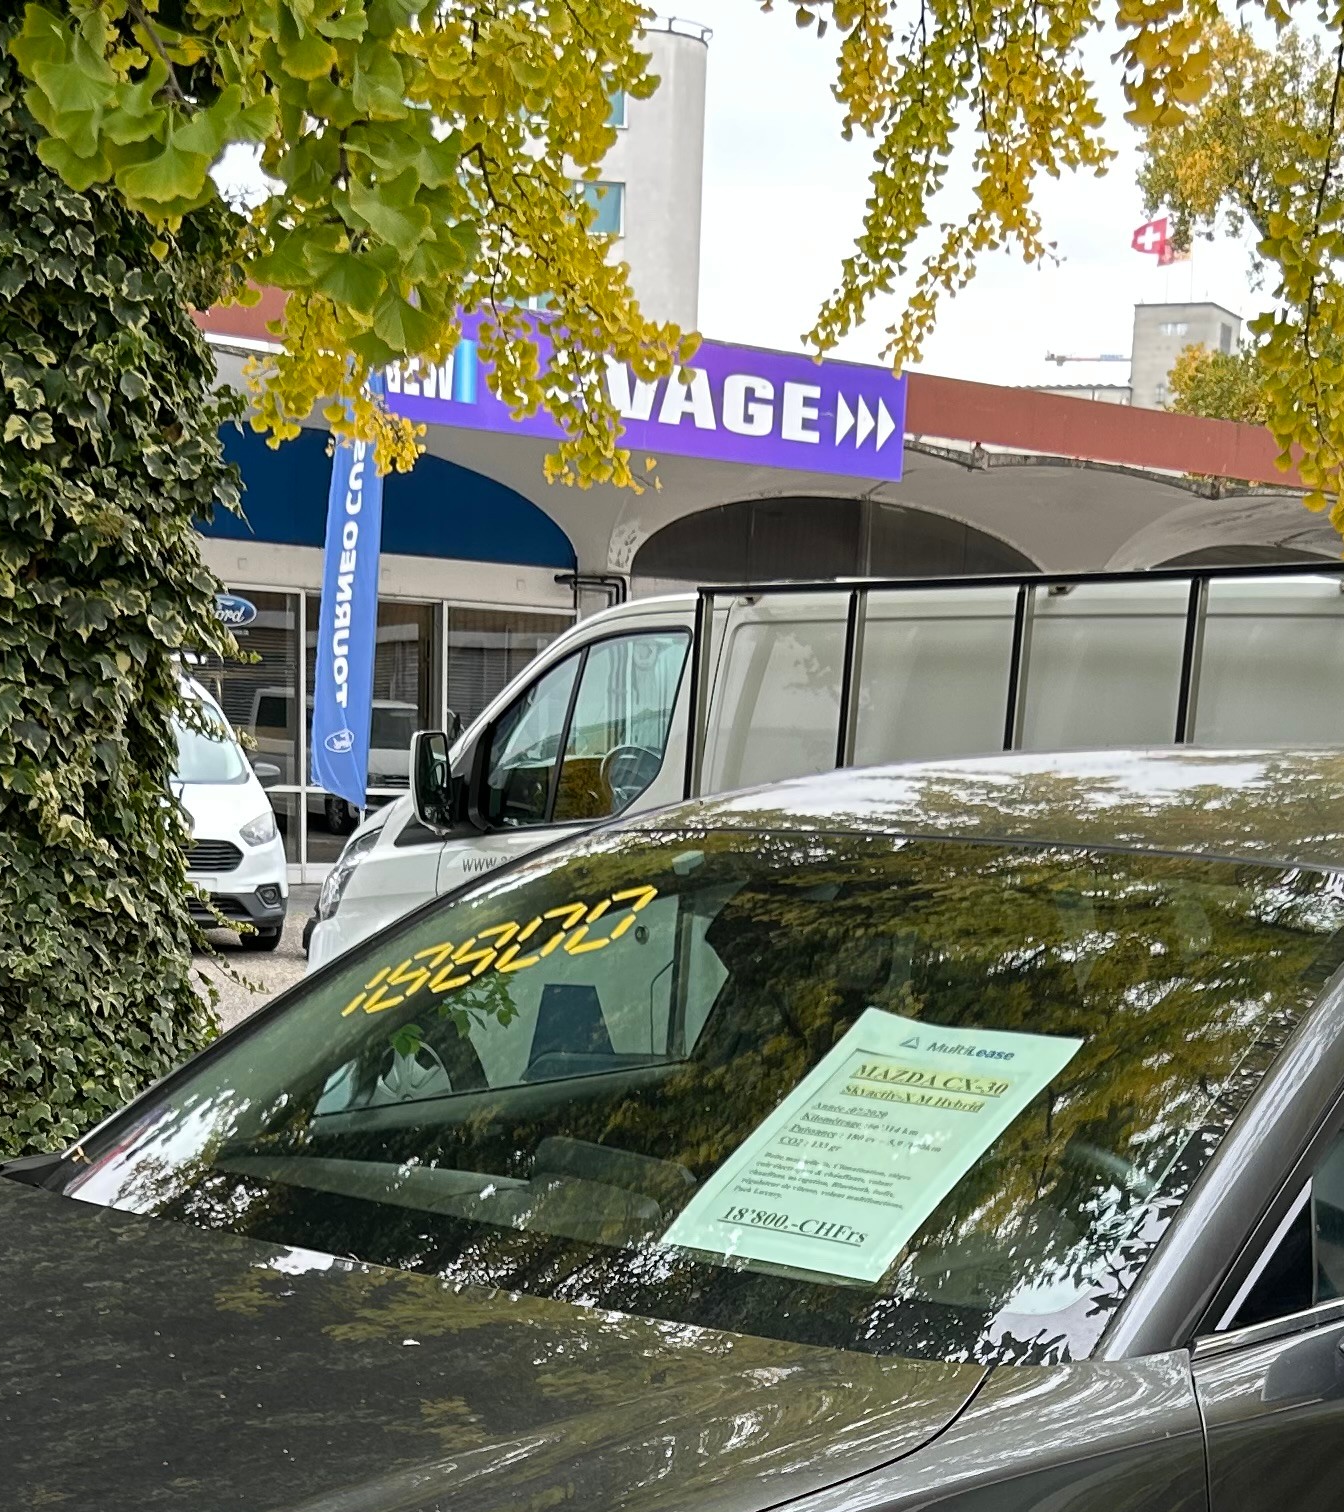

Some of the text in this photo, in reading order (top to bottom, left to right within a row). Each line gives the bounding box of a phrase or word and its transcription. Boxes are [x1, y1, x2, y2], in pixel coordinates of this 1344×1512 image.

[501, 346, 821, 444] VAGE
[341, 884, 658, 1016] 18800
[927, 1042, 1015, 1061] MultiLease
[856, 1064, 1009, 1096] MAZDA CX-30
[935, 1096, 986, 1113] Hybrid
